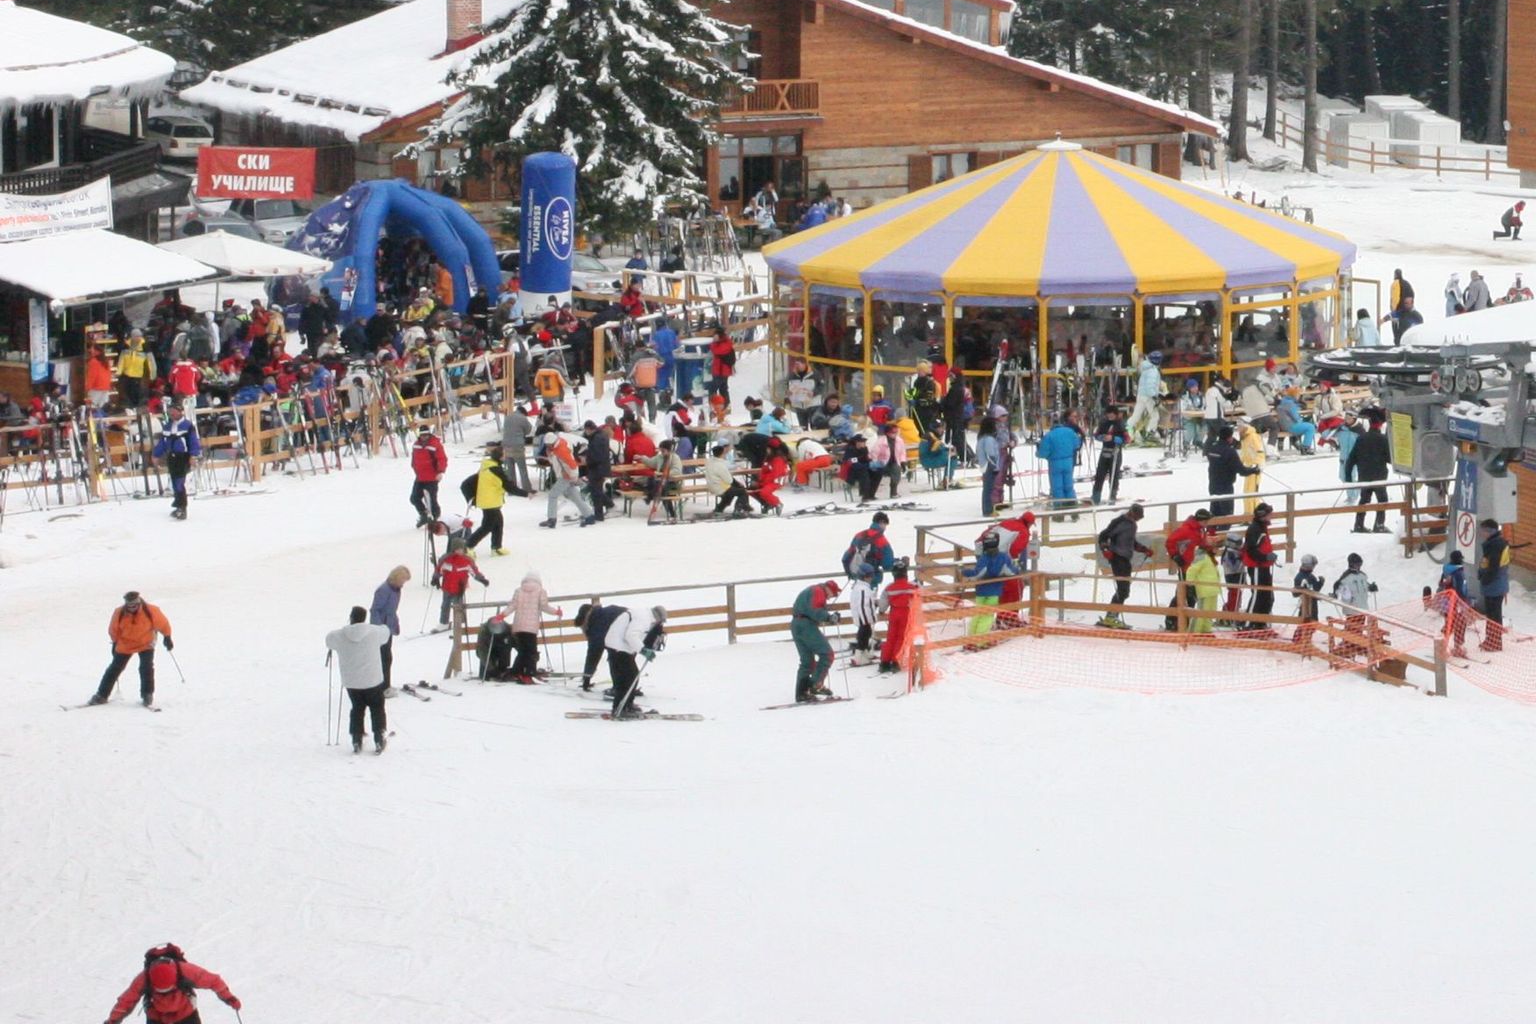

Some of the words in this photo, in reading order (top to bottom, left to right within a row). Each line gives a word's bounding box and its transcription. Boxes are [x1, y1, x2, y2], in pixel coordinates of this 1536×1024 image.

[237, 154, 271, 170] СКИ
[211, 174, 295, 194] УЧИЛИЩЕ
[532, 205, 541, 253] ESSENTIAL
[561, 210, 569, 245] NIVEA
